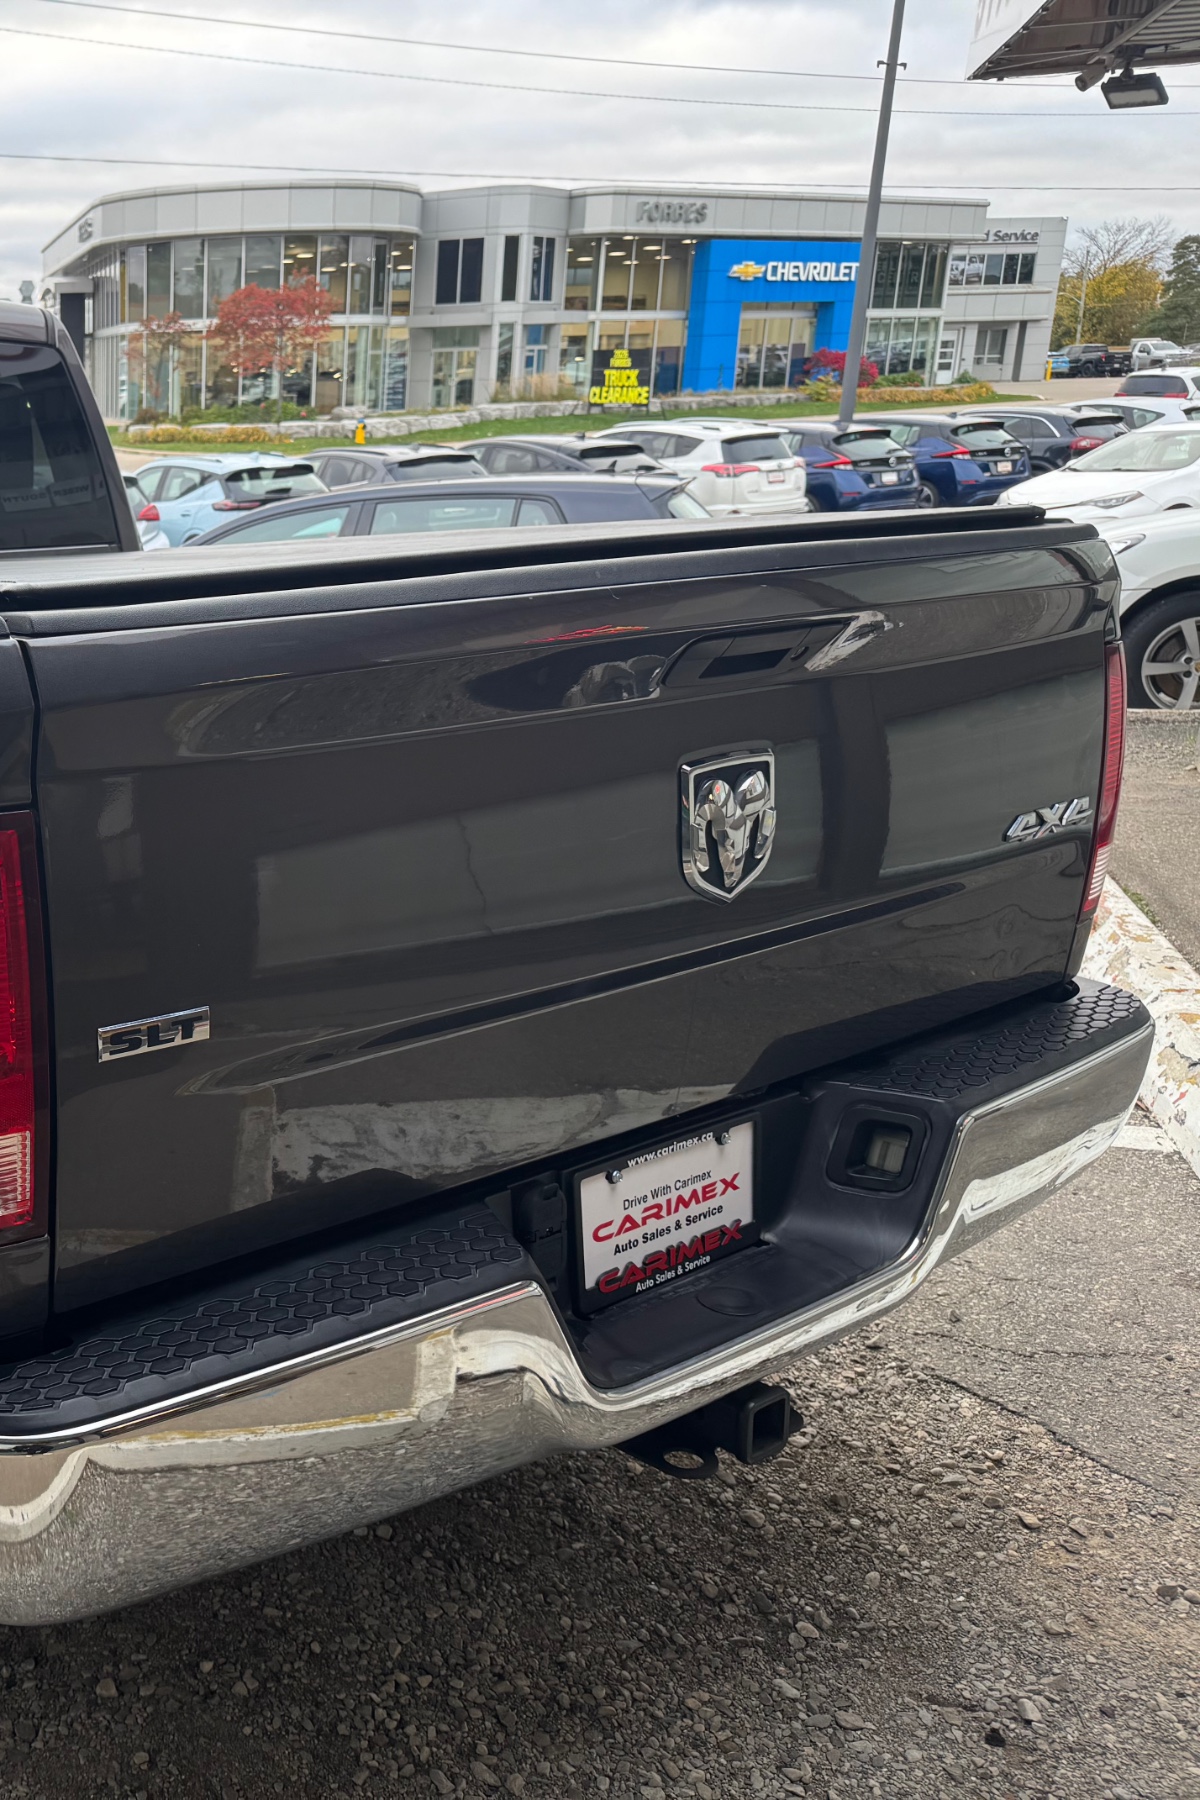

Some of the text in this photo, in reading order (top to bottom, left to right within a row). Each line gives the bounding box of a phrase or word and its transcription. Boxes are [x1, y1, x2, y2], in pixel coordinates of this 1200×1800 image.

[636, 202, 708, 224] FORBES
[993, 229, 1040, 242] Service
[766, 261, 860, 282] CHEVROLET
[589, 386, 650, 404] CLEARANCE
[604, 369, 640, 387] TRUCK
[106, 1014, 204, 1056] SLT
[627, 1131, 714, 1168] www.carimex.ca
[592, 1172, 741, 1243] CARIMEX
[623, 1170, 712, 1211] Drive With Carimex
[614, 1204, 724, 1256] Auto Sales & Service
[597, 1219, 743, 1293] CARIMEX
[635, 1254, 711, 1293] Auto Sales & Service
